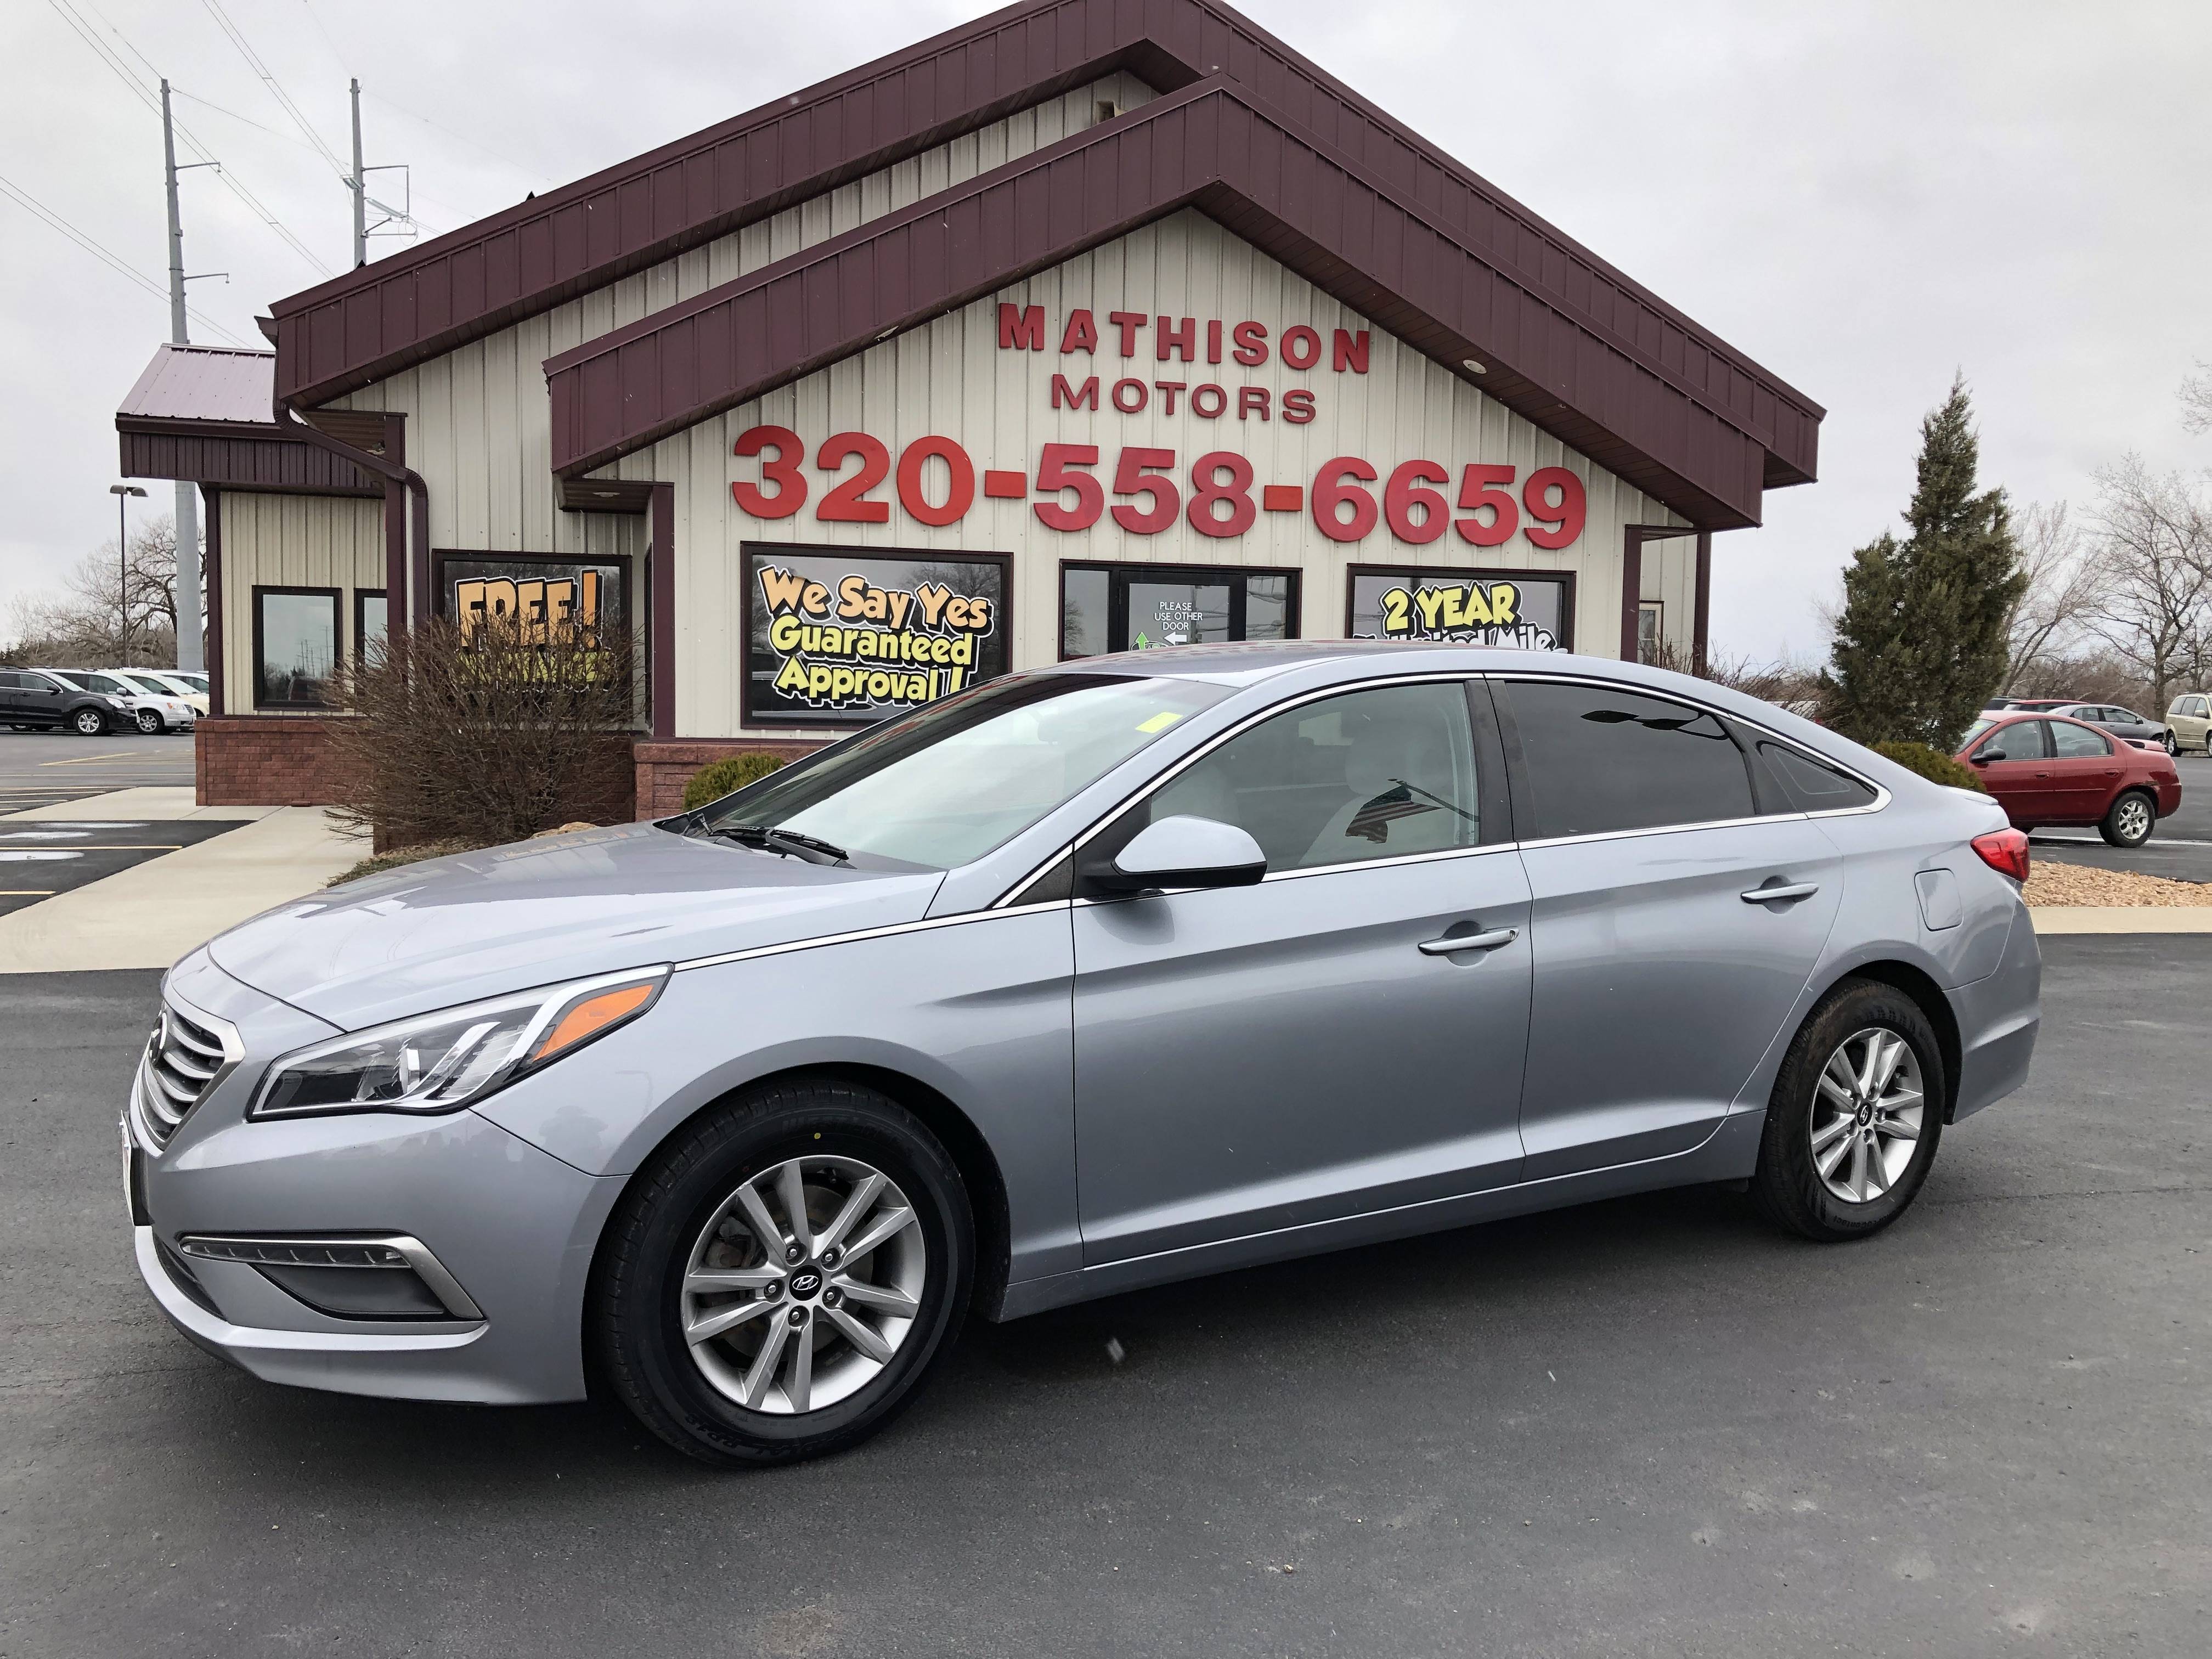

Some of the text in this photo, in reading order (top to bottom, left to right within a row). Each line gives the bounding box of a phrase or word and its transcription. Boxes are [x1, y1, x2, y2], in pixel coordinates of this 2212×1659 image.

[998, 302, 1370, 374] MATHISON
[1052, 374, 1317, 424] MOTORS
[732, 425, 1587, 550] 320-558-6659
[760, 566, 988, 629] We Say Yes
[1154, 612, 1203, 621] USE OTHER
[1159, 601, 1192, 611] PLEASE
[1383, 582, 1518, 631] 2 YEAR
[770, 614, 973, 665] Guaranteed
[1163, 622, 1189, 630] DOOR
